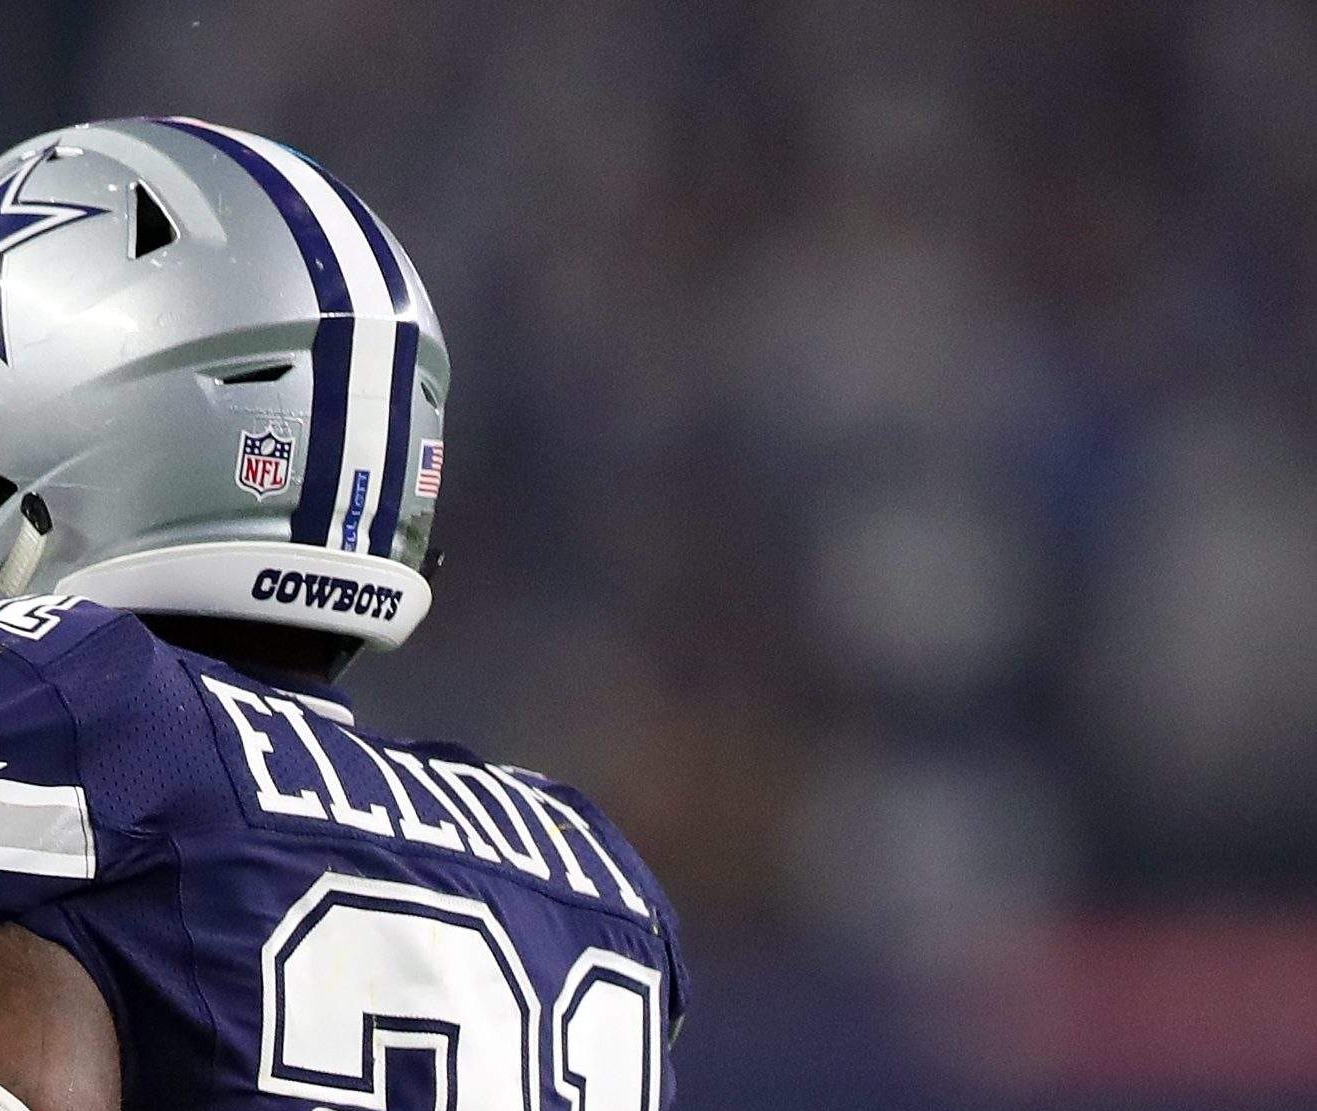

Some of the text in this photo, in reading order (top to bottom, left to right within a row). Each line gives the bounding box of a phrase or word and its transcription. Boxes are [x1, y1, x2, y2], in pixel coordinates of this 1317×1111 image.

[245, 456, 284, 486] NFL
[251, 567, 403, 621] COWBOYS
[200, 674, 651, 918] ELLIOTT
